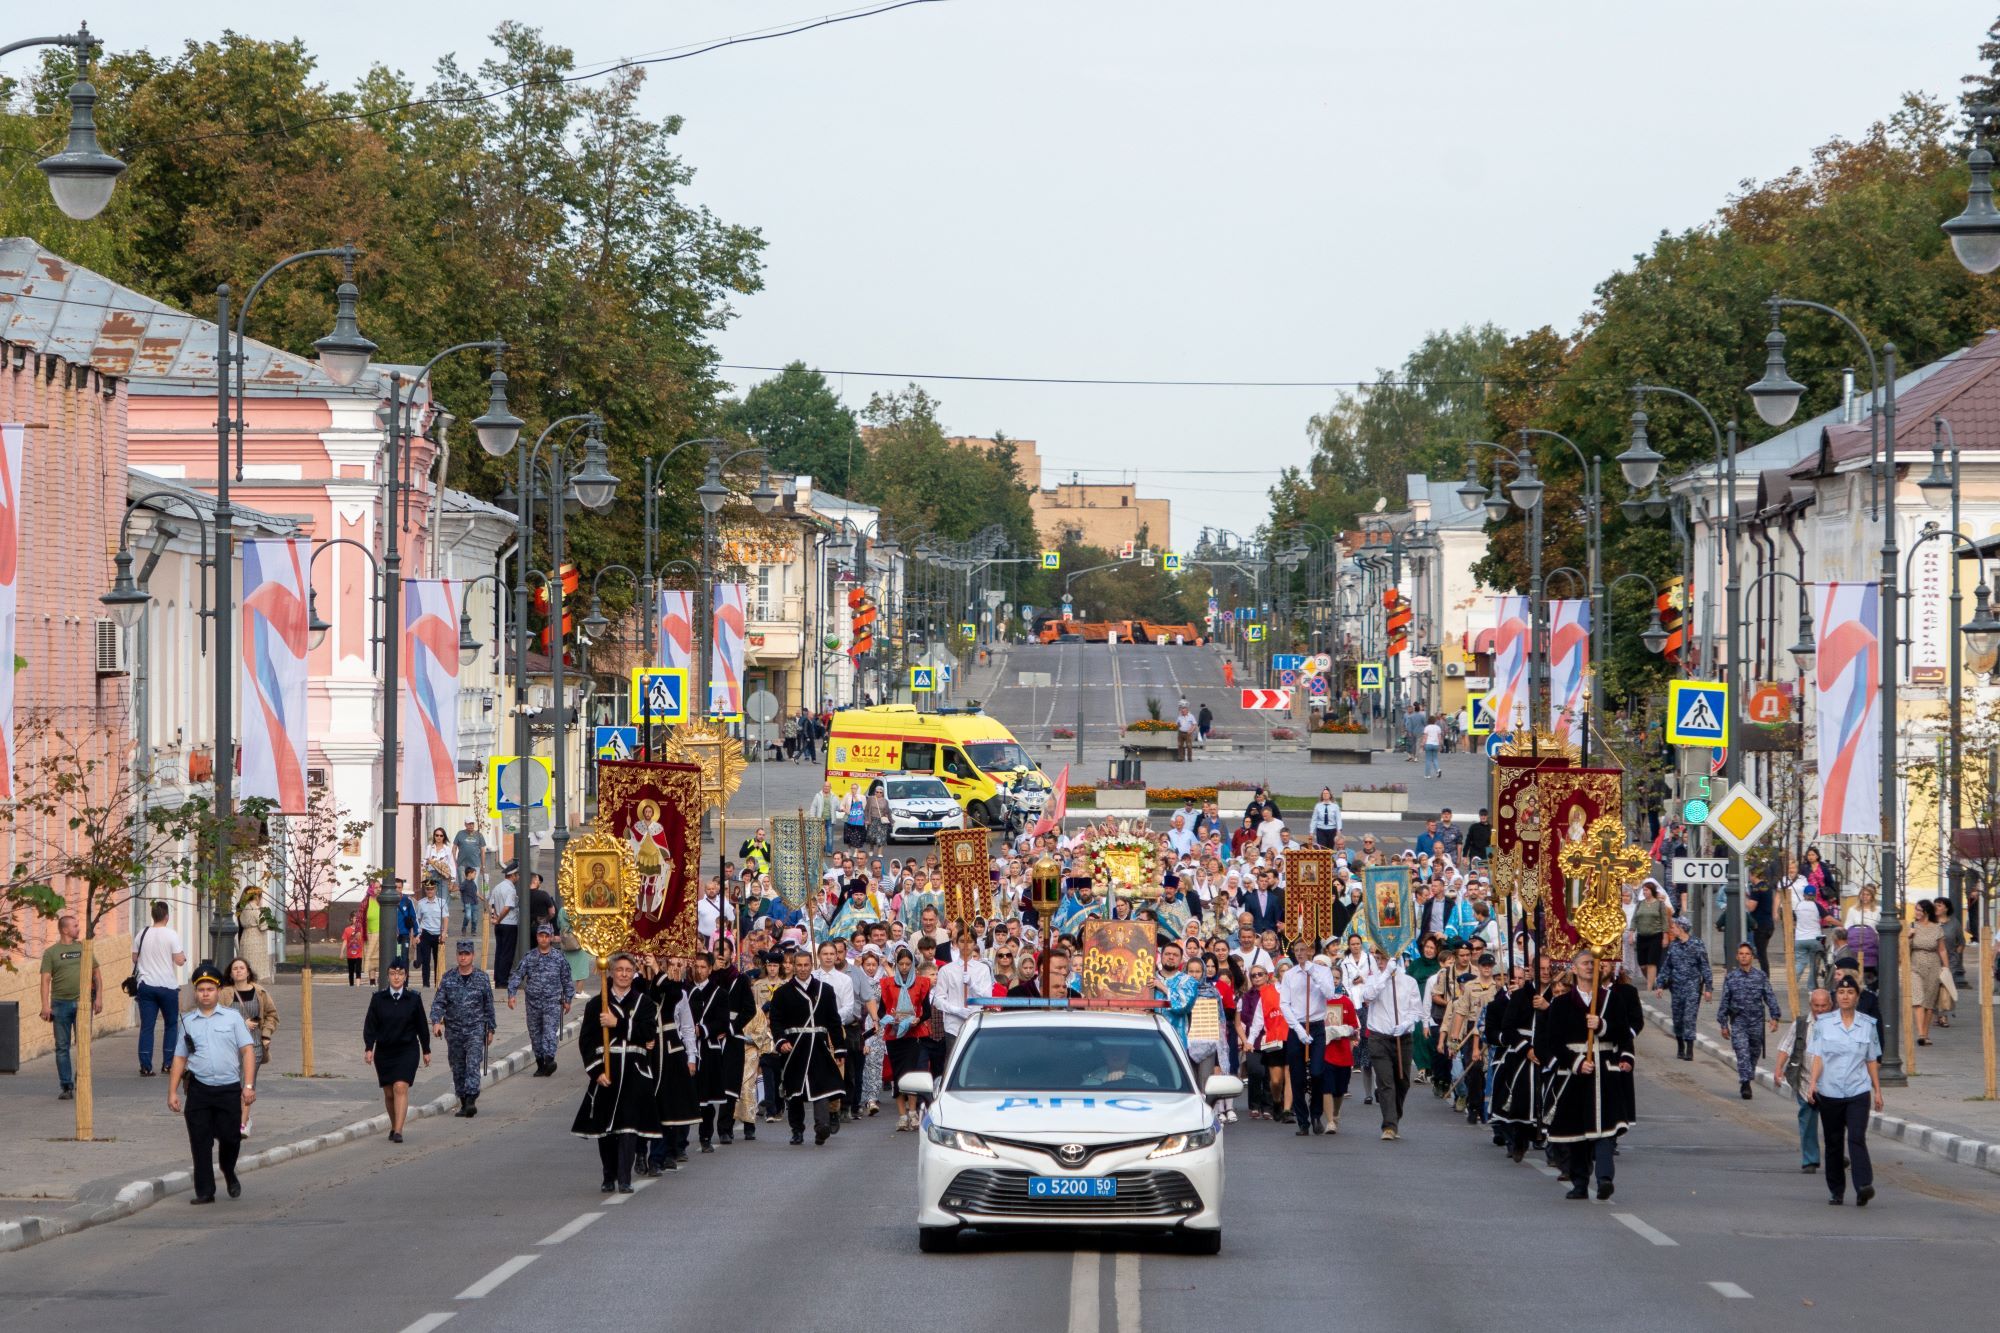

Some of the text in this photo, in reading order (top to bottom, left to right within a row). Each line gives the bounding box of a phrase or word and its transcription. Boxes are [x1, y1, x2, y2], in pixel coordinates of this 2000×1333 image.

[1317, 658, 1328, 666] 30
[1760, 696, 1779, 718] Д
[861, 745, 880, 757] 112
[1699, 776, 1710, 797] 5
[1684, 862, 1728, 878] СТО
[996, 1098, 1152, 1111] ДПС
[1051, 1179, 1087, 1194] 5200
[1096, 1179, 1110, 1190] 50
